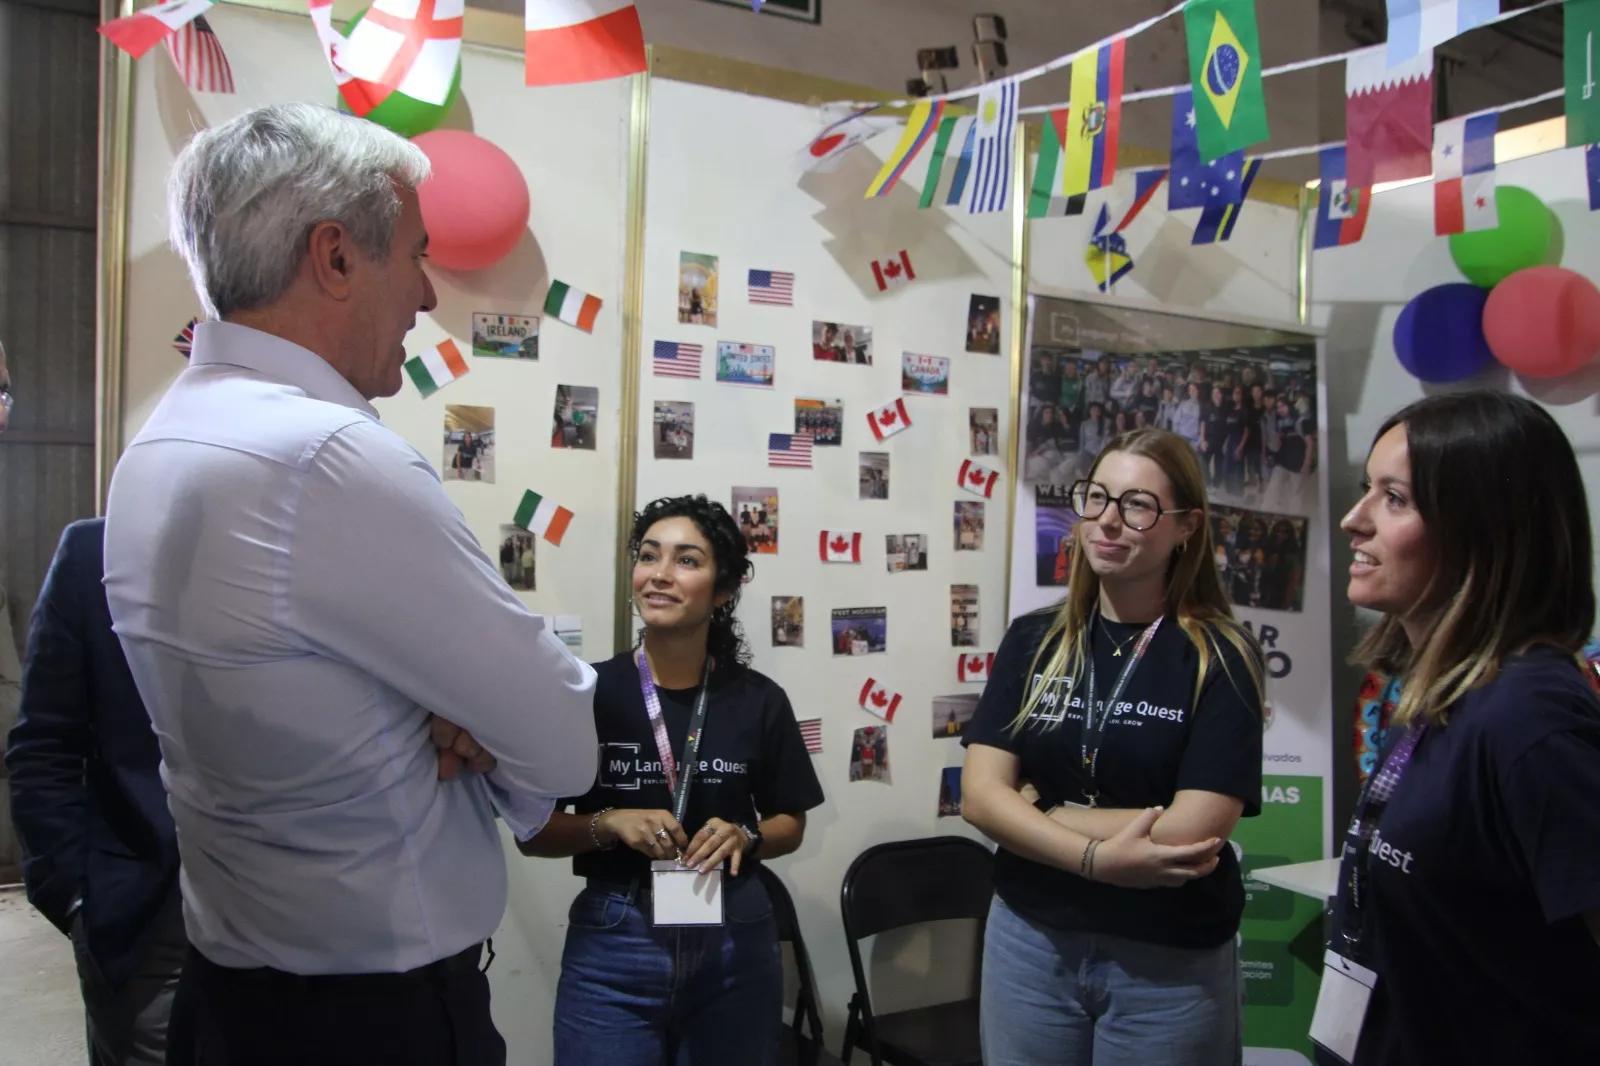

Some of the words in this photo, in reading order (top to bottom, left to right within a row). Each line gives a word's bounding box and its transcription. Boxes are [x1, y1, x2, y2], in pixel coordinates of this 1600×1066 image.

[487, 325, 527, 338] IRELAND
[1136, 701, 1184, 722] Quest
[609, 759, 631, 776] My
